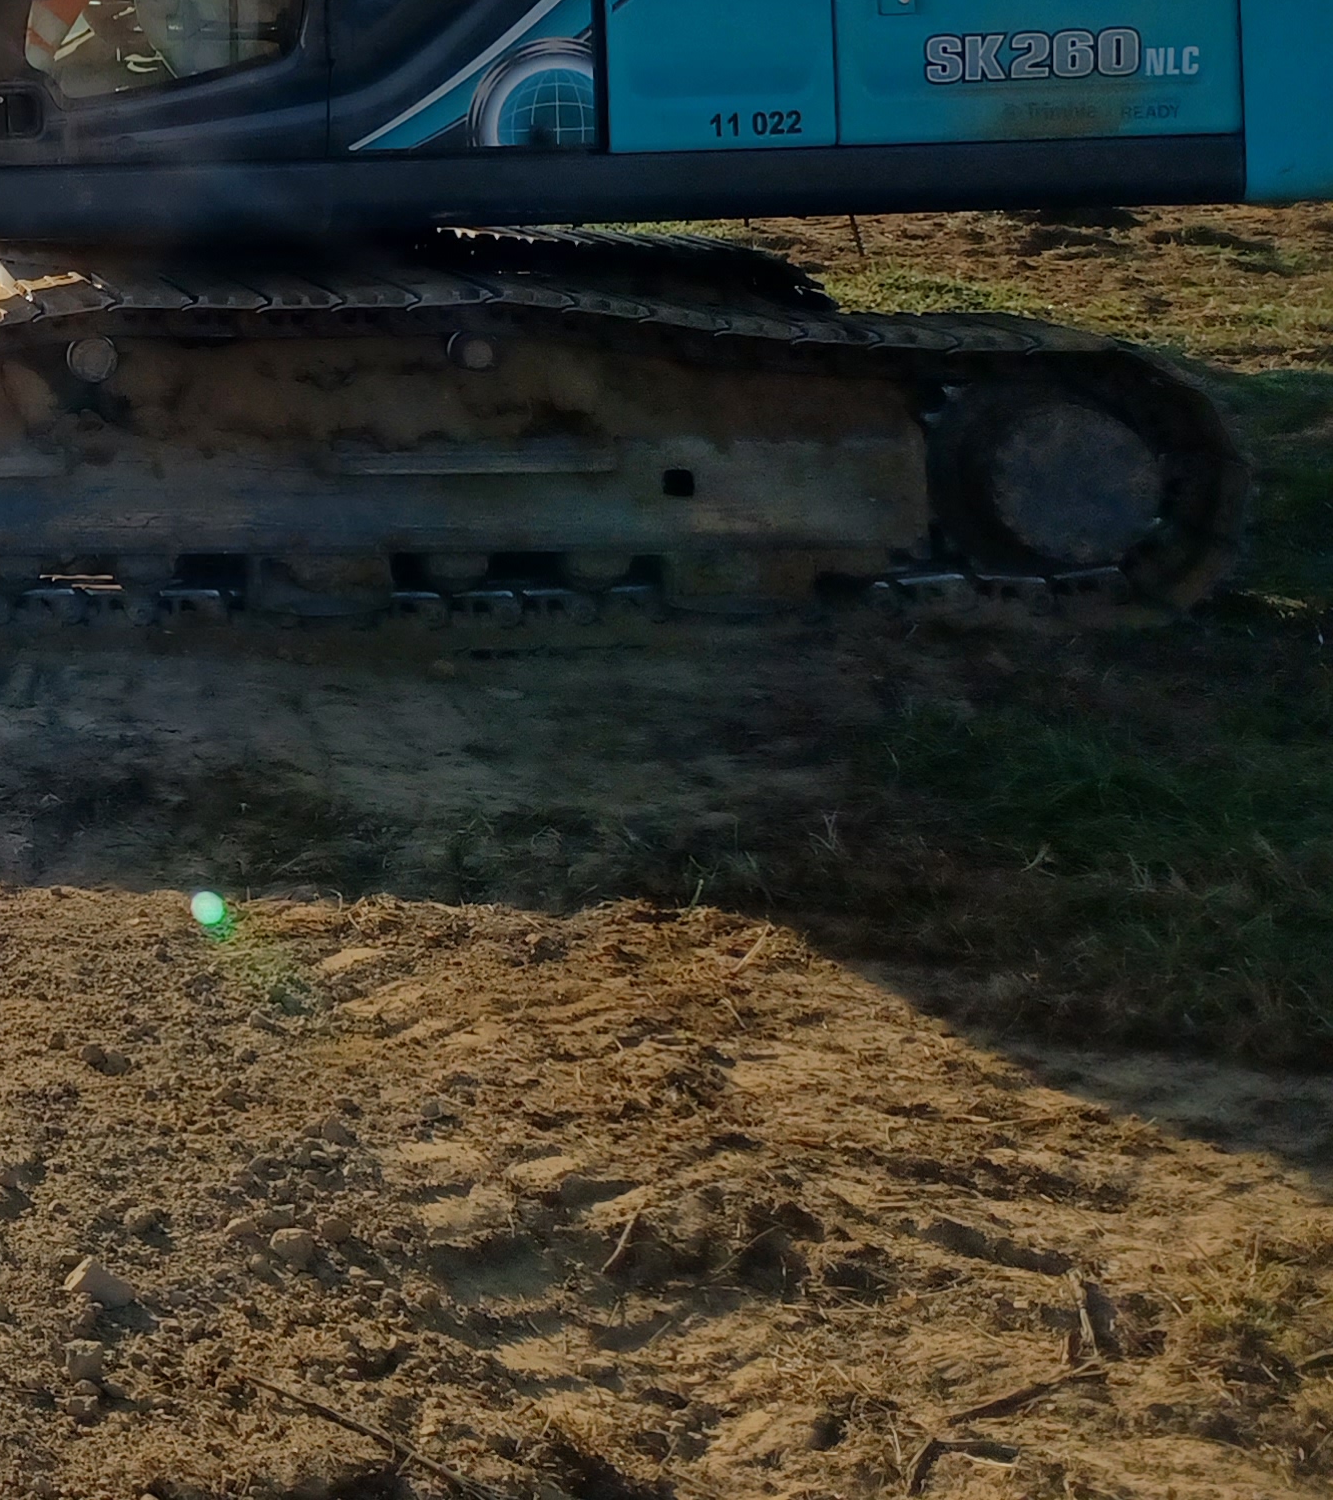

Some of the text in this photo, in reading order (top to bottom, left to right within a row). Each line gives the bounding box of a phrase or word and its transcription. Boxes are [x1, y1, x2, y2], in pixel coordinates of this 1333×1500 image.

[925, 26, 1200, 85] SK260 NLC
[710, 109, 802, 137] 11 022
[1121, 104, 1180, 119] READY
